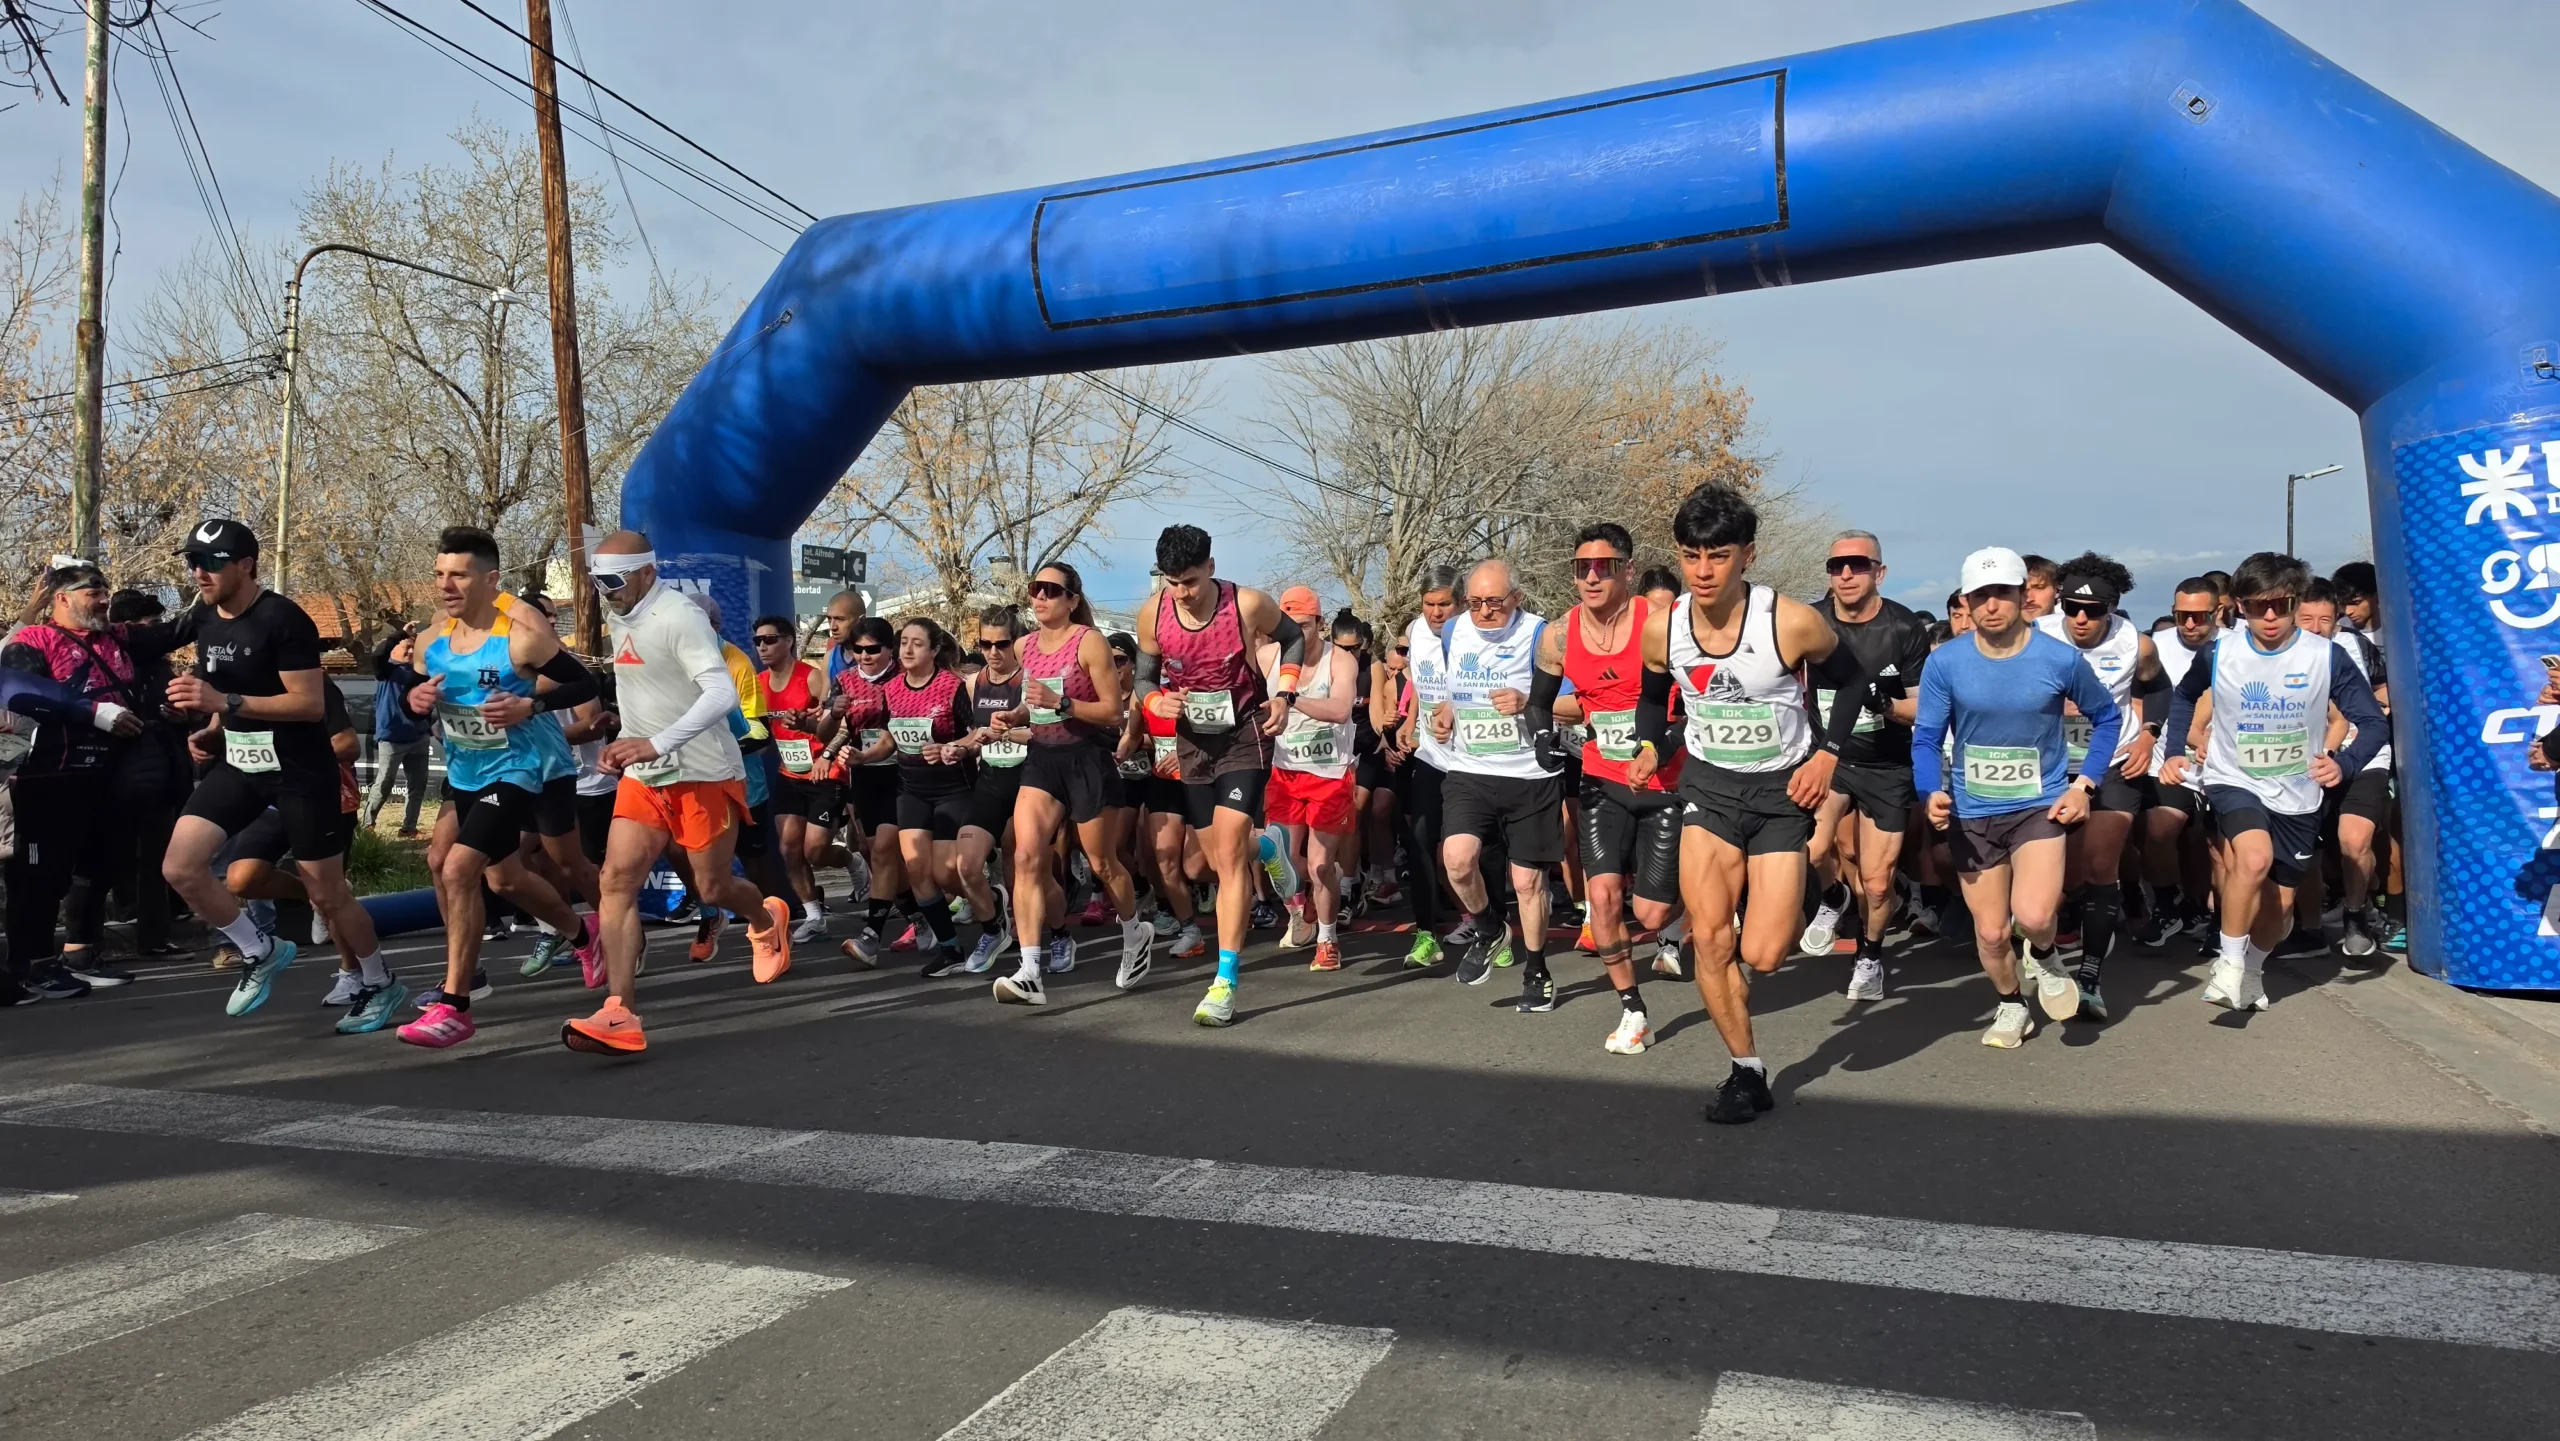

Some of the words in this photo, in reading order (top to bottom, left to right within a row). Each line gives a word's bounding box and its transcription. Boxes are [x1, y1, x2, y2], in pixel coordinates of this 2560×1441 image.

[803, 547, 814, 556] Int.
[815, 549, 835, 559] Alfredo
[803, 557, 820, 566] Cinca
[1455, 670, 1508, 682] MARATON
[978, 699, 1009, 708] PUSH
[2240, 701, 2306, 712] MARATON
[458, 707, 475, 716] 10K
[766, 710, 789, 719] PUS
[1184, 705, 1229, 721] 1267
[1722, 709, 1743, 717] 10K
[1611, 714, 1629, 723] 10K
[447, 718, 498, 736] 1120
[1463, 722, 1513, 740] 1248
[893, 730, 929, 743] 1034
[1703, 724, 1773, 744] 1229
[987, 741, 1021, 754] 1187
[1291, 742, 1334, 759] 1040
[2244, 744, 2303, 763] 1175
[229, 748, 274, 763] 1250
[780, 750, 809, 762] 1053
[1988, 751, 2010, 759] 10K
[1969, 762, 2034, 781] 1226
